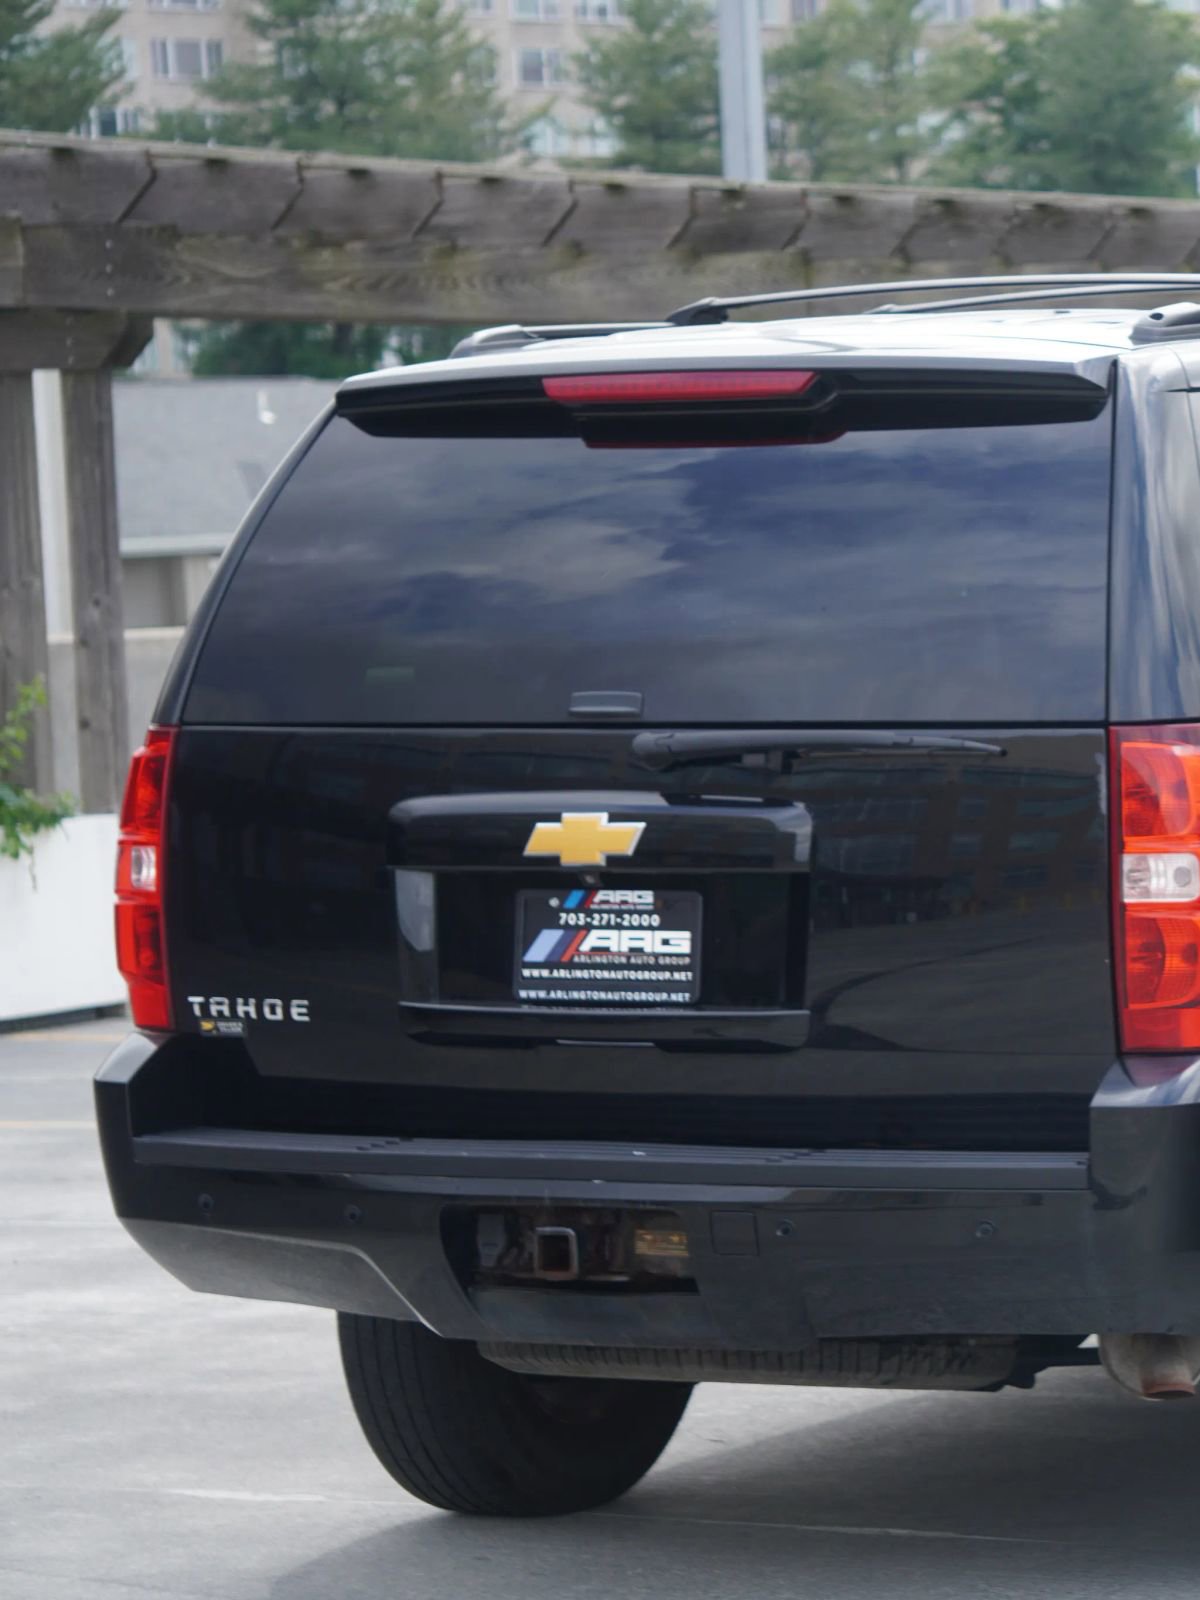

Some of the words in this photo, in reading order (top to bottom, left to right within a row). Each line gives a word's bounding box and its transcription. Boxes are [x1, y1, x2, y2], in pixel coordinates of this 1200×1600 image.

[592, 889, 654, 903] AAG
[559, 912, 661, 927] 703-271-2000
[578, 930, 692, 954] AAG
[573, 954, 627, 964] ARLINGTON
[630, 956, 656, 965] AUTO
[658, 956, 691, 966] GROUP
[522, 969, 693, 981] WWW.ARLINGTONAUTOGROUP.NET
[518, 990, 690, 1002] WWW.ARLINGTONAUTOGROUP.NET
[187, 996, 311, 1022] TAHOE
